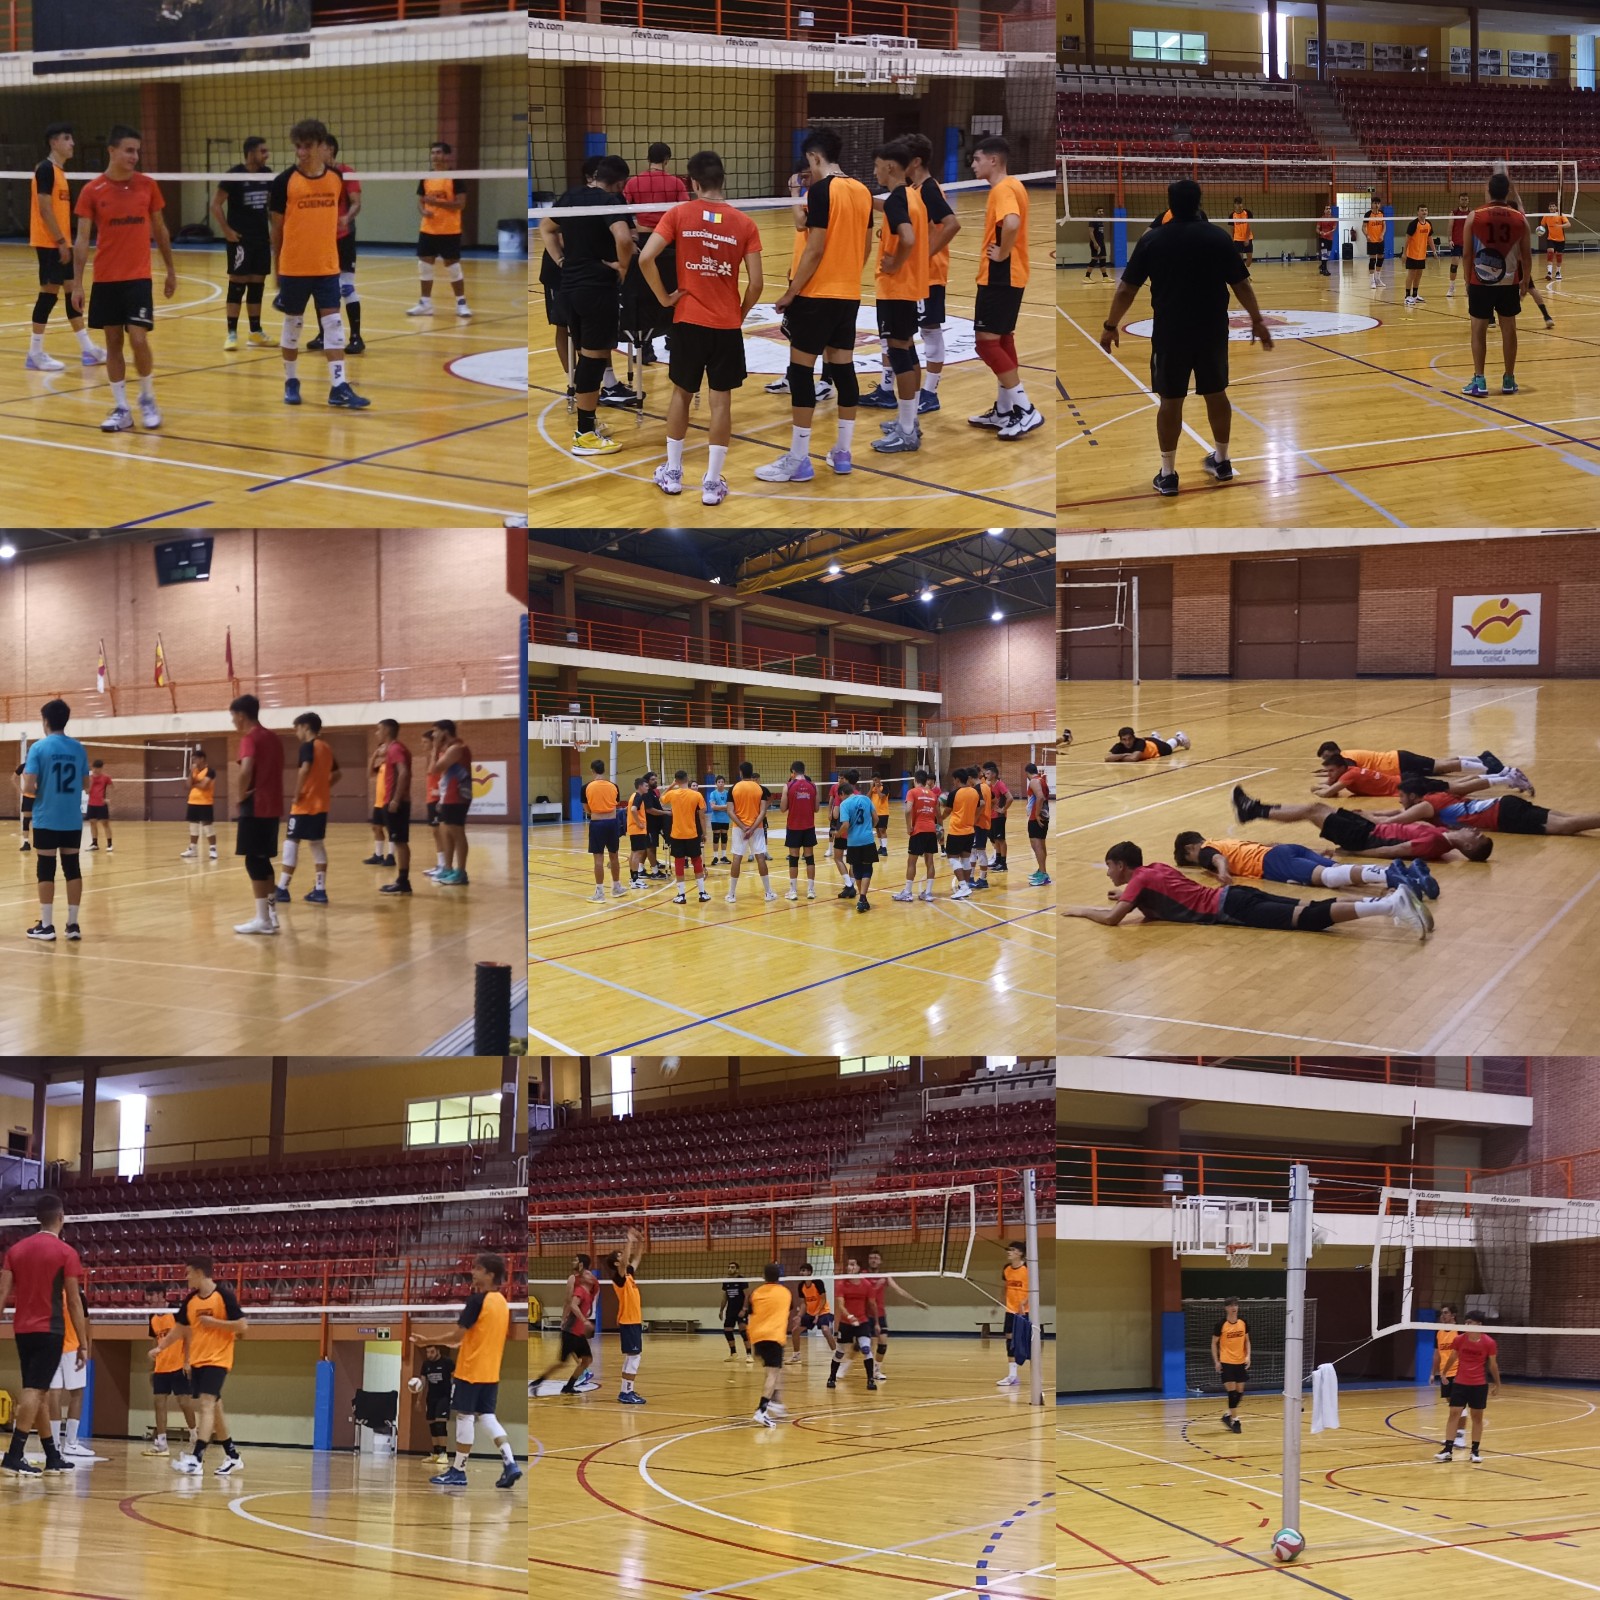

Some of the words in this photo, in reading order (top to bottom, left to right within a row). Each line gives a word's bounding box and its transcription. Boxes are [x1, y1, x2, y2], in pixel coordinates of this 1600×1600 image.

[632, 29, 669, 40] rfevb.com
[725, 38, 759, 47] rfevb.com
[807, 44, 835, 53] rfevb.com
[297, 199, 335, 210] CUENCA
[1487, 222, 1511, 244] 13
[334, 364, 342, 380] FILA
[52, 762, 76, 794] 12
[288, 817, 296, 831] 9
[1491, 1196, 1521, 1204] rfevb.com
[1567, 1200, 1595, 1208] rfevb.com
